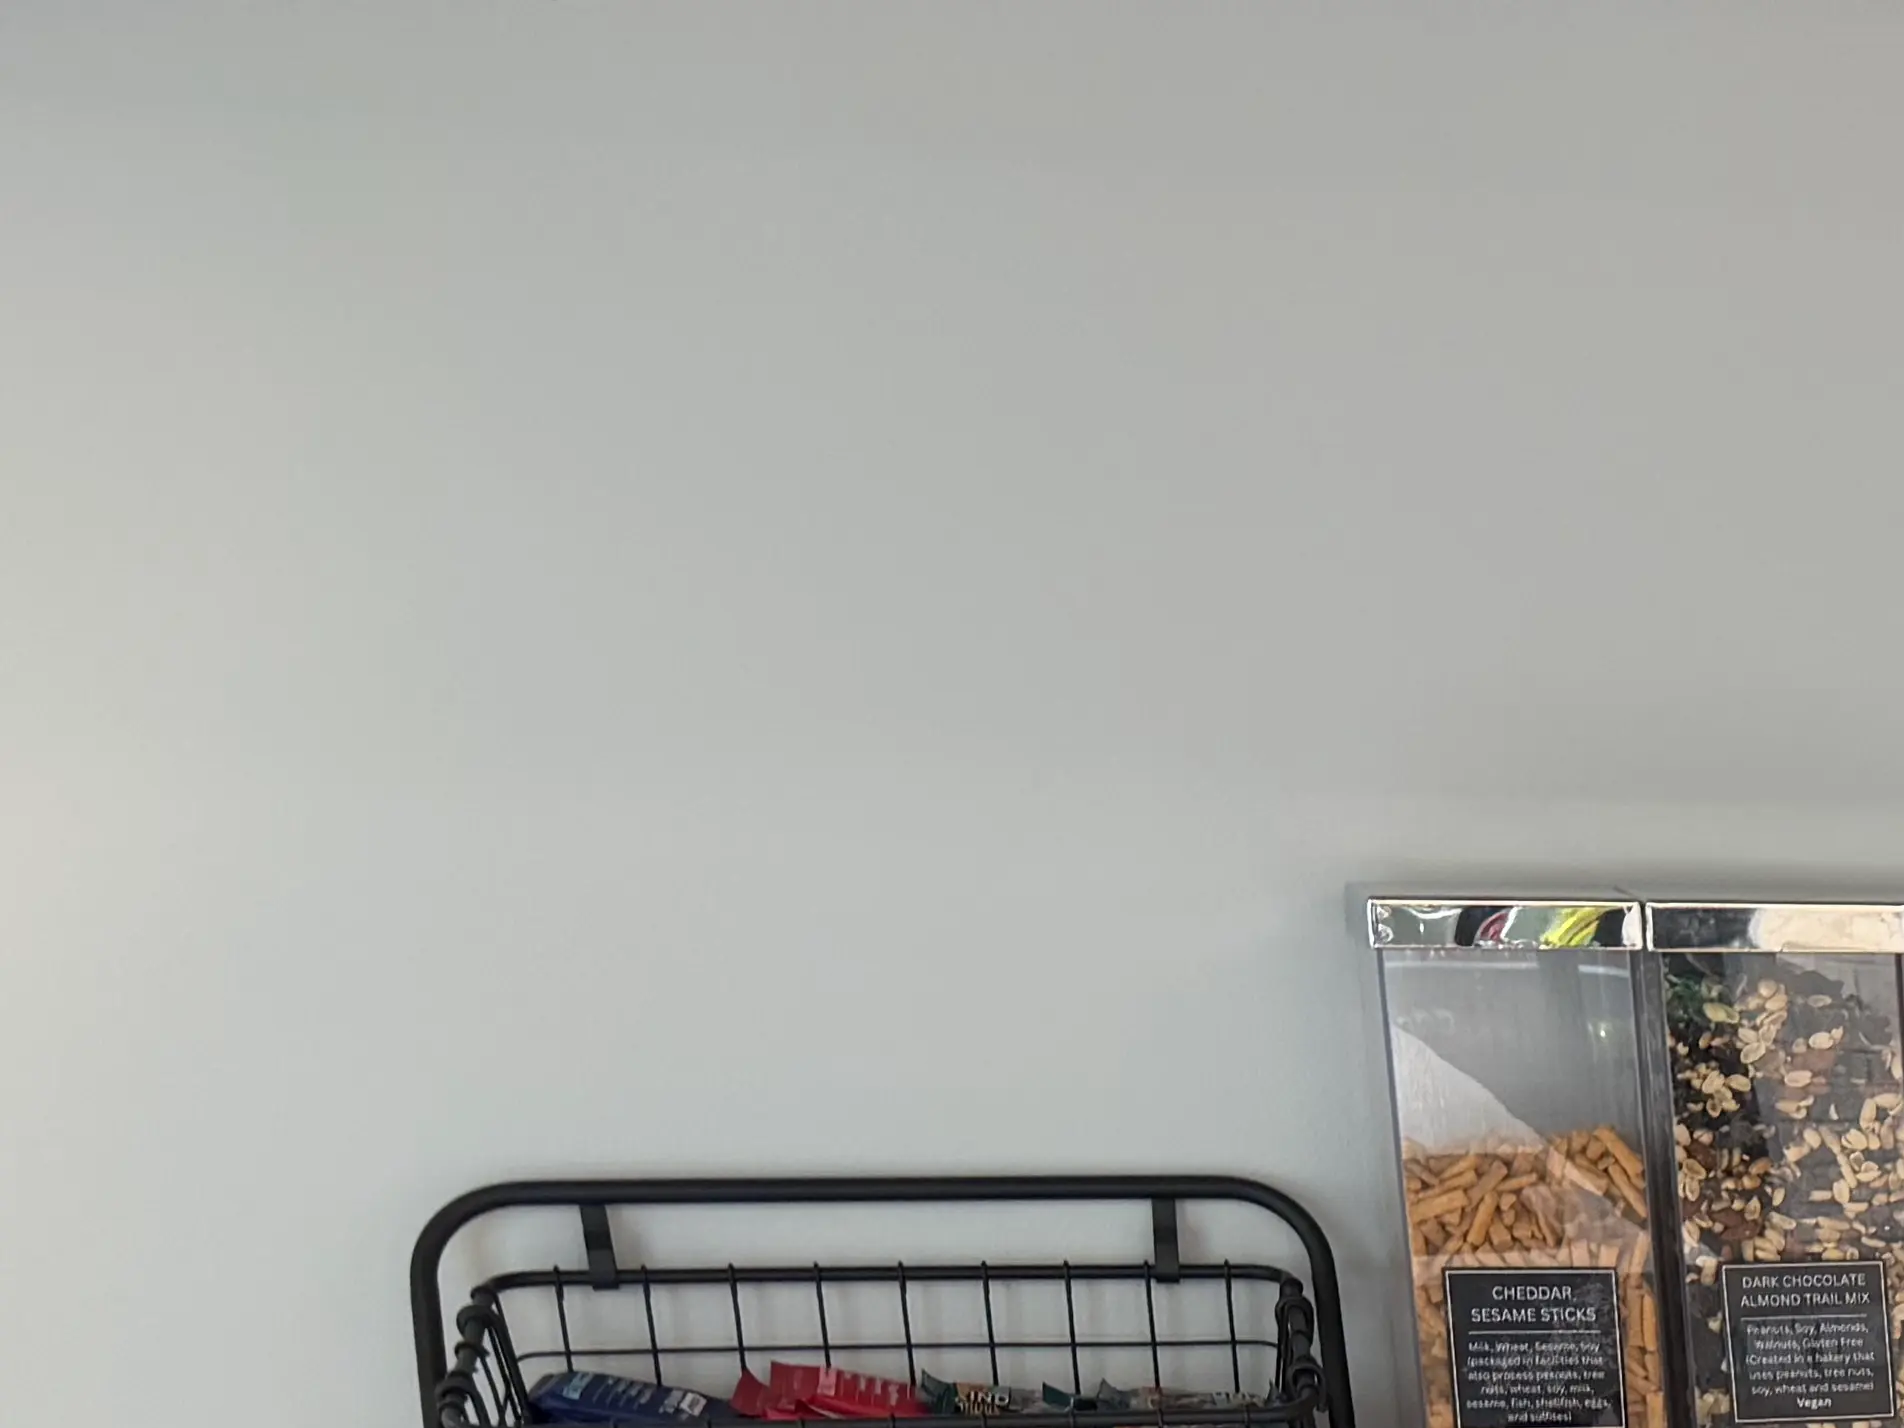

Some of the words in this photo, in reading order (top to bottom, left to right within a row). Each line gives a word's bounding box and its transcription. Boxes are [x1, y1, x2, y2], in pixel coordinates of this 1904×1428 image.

[1742, 1276, 1779, 1288] DARK
[1783, 1273, 1865, 1288] CHOCOLATE
[1741, 1293, 1801, 1307] ALMOND
[1805, 1293, 1842, 1305] TRAIL
[1845, 1292, 1870, 1304] MIX
[1471, 1307, 1536, 1322] SESAME
[1541, 1307, 1596, 1322] STICKS
[1797, 1397, 1832, 1409] Vegan
